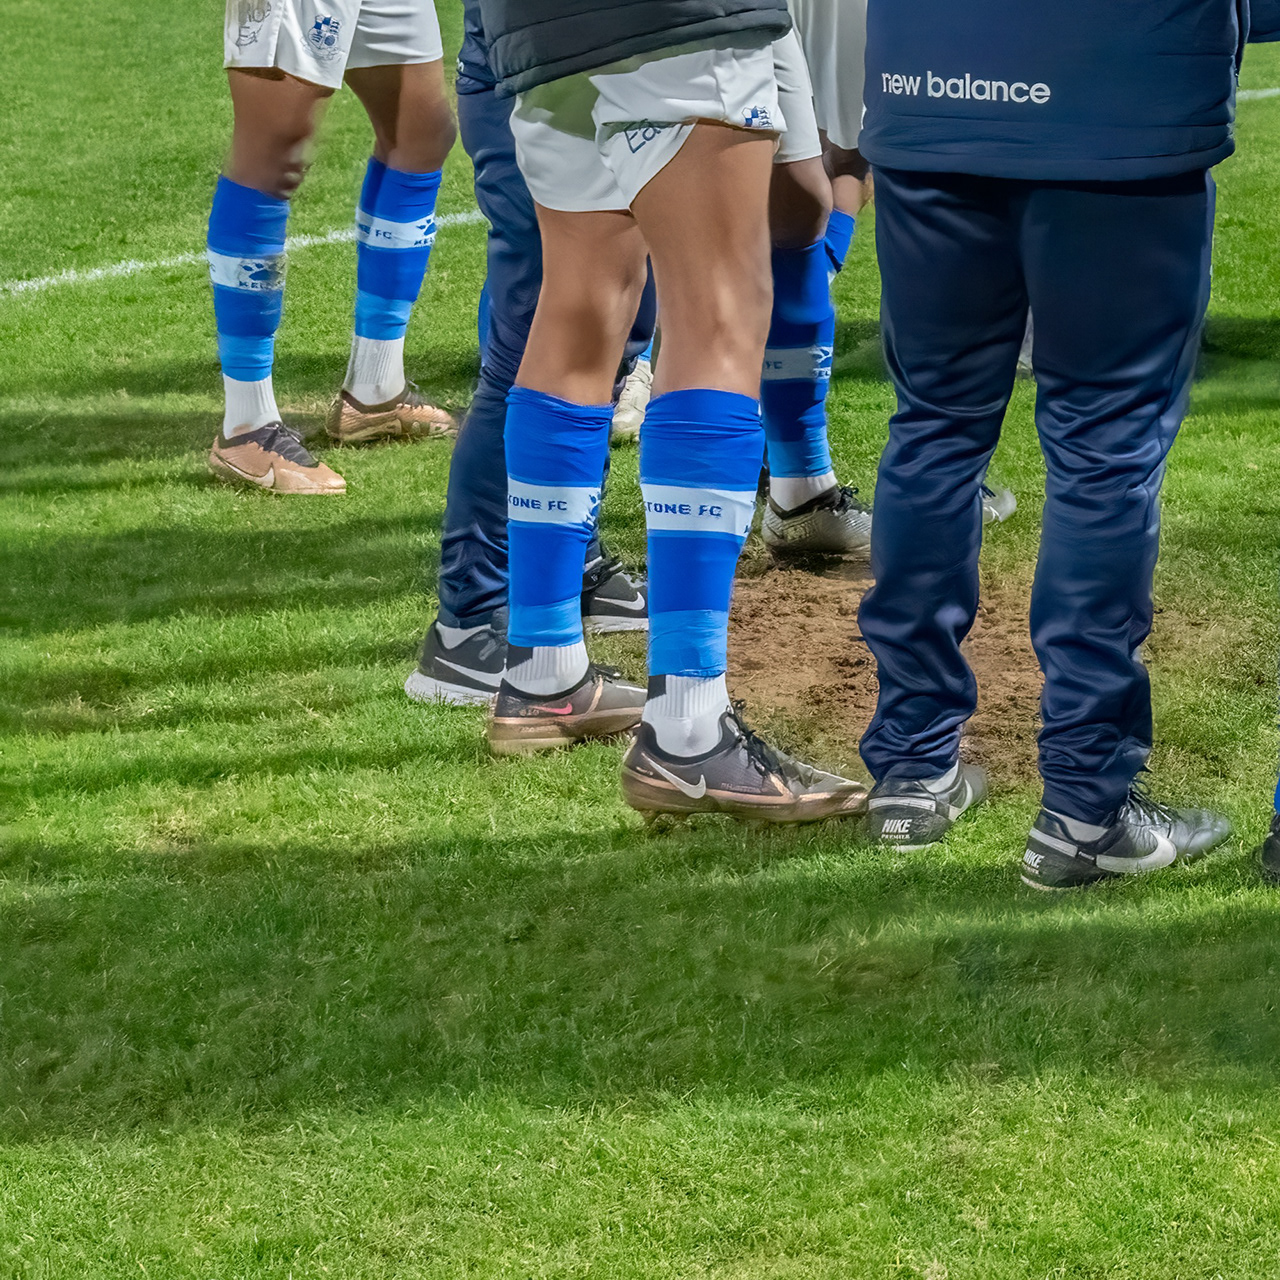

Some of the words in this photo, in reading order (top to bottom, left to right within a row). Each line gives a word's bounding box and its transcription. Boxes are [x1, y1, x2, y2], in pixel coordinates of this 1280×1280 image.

[881, 71, 922, 97] new
[926, 70, 1051, 105] balance
[547, 500, 568, 511] FC
[698, 503, 722, 518] FC
[882, 818, 912, 834] NIKE
[1022, 847, 1045, 870] NIKE
